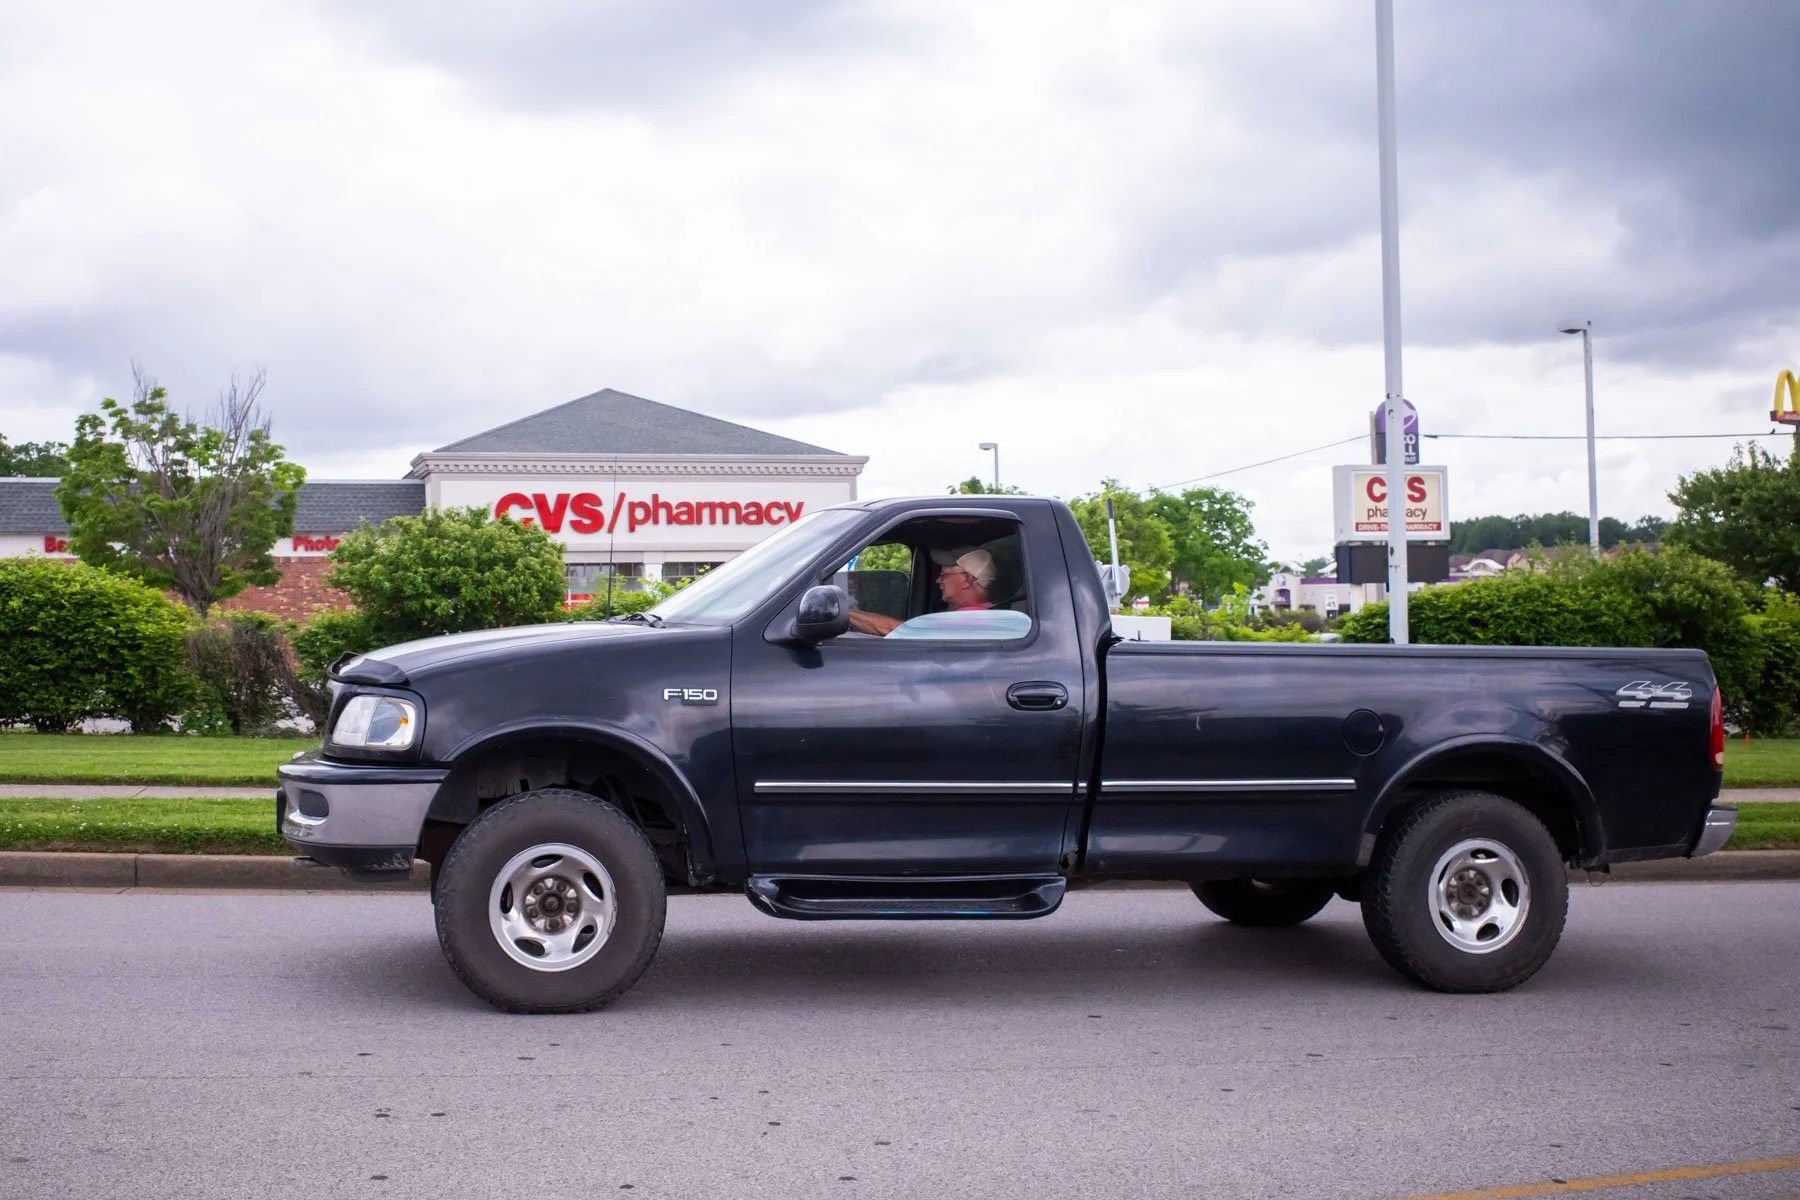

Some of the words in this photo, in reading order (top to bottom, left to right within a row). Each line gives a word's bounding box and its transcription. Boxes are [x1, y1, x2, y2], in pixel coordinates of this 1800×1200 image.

[1366, 476, 1427, 503] CS
[1367, 506, 1428, 521] phaacy
[663, 688, 718, 701] F-150
